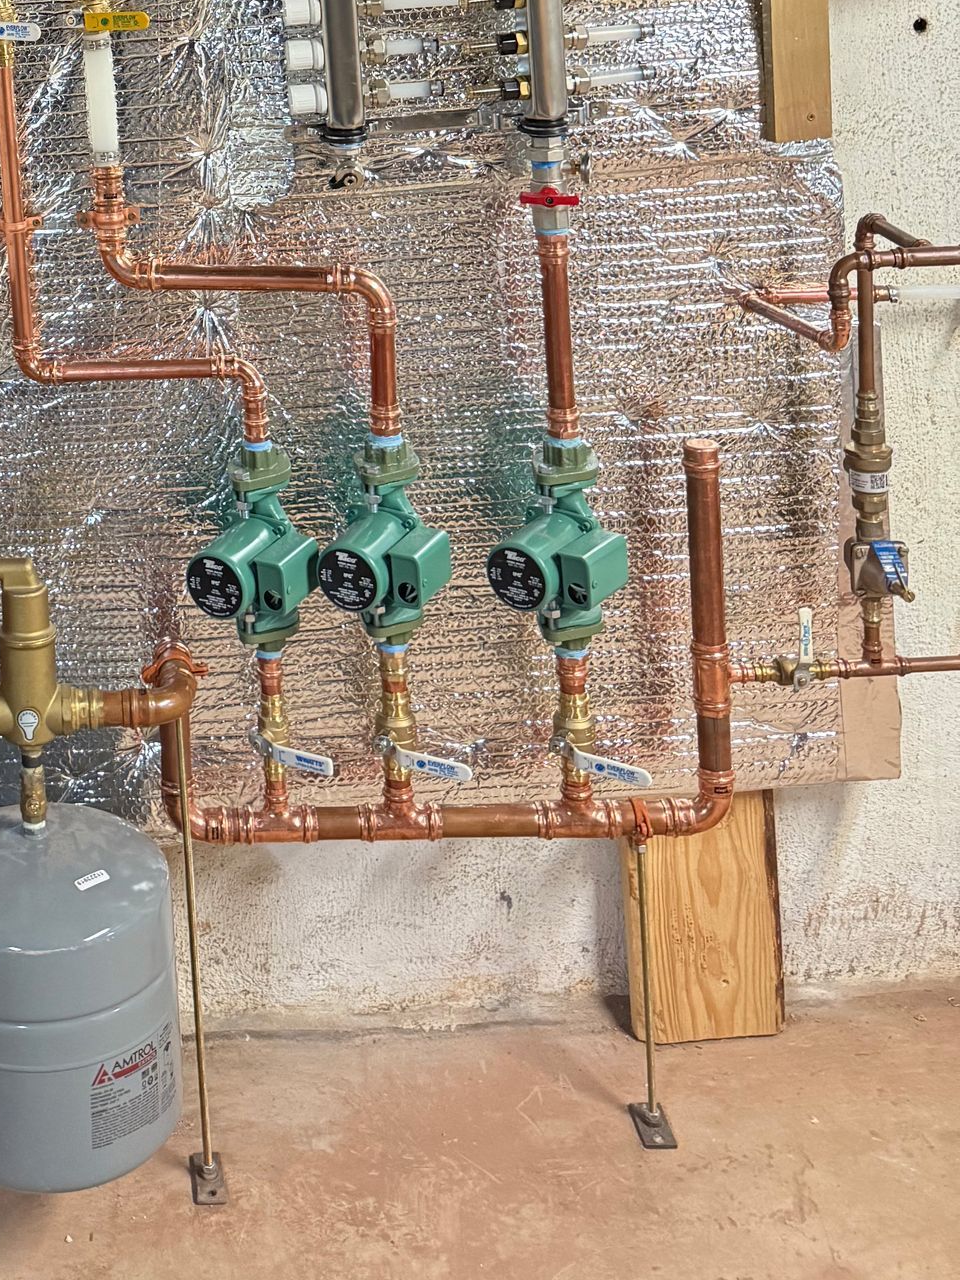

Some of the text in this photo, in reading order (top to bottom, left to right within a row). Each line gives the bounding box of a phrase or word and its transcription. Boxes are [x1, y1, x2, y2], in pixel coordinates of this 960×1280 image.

[427, 759, 456, 771] EVERFLOW
[606, 763, 636, 776] EVERFLOW
[111, 1040, 157, 1072] AMTROL
